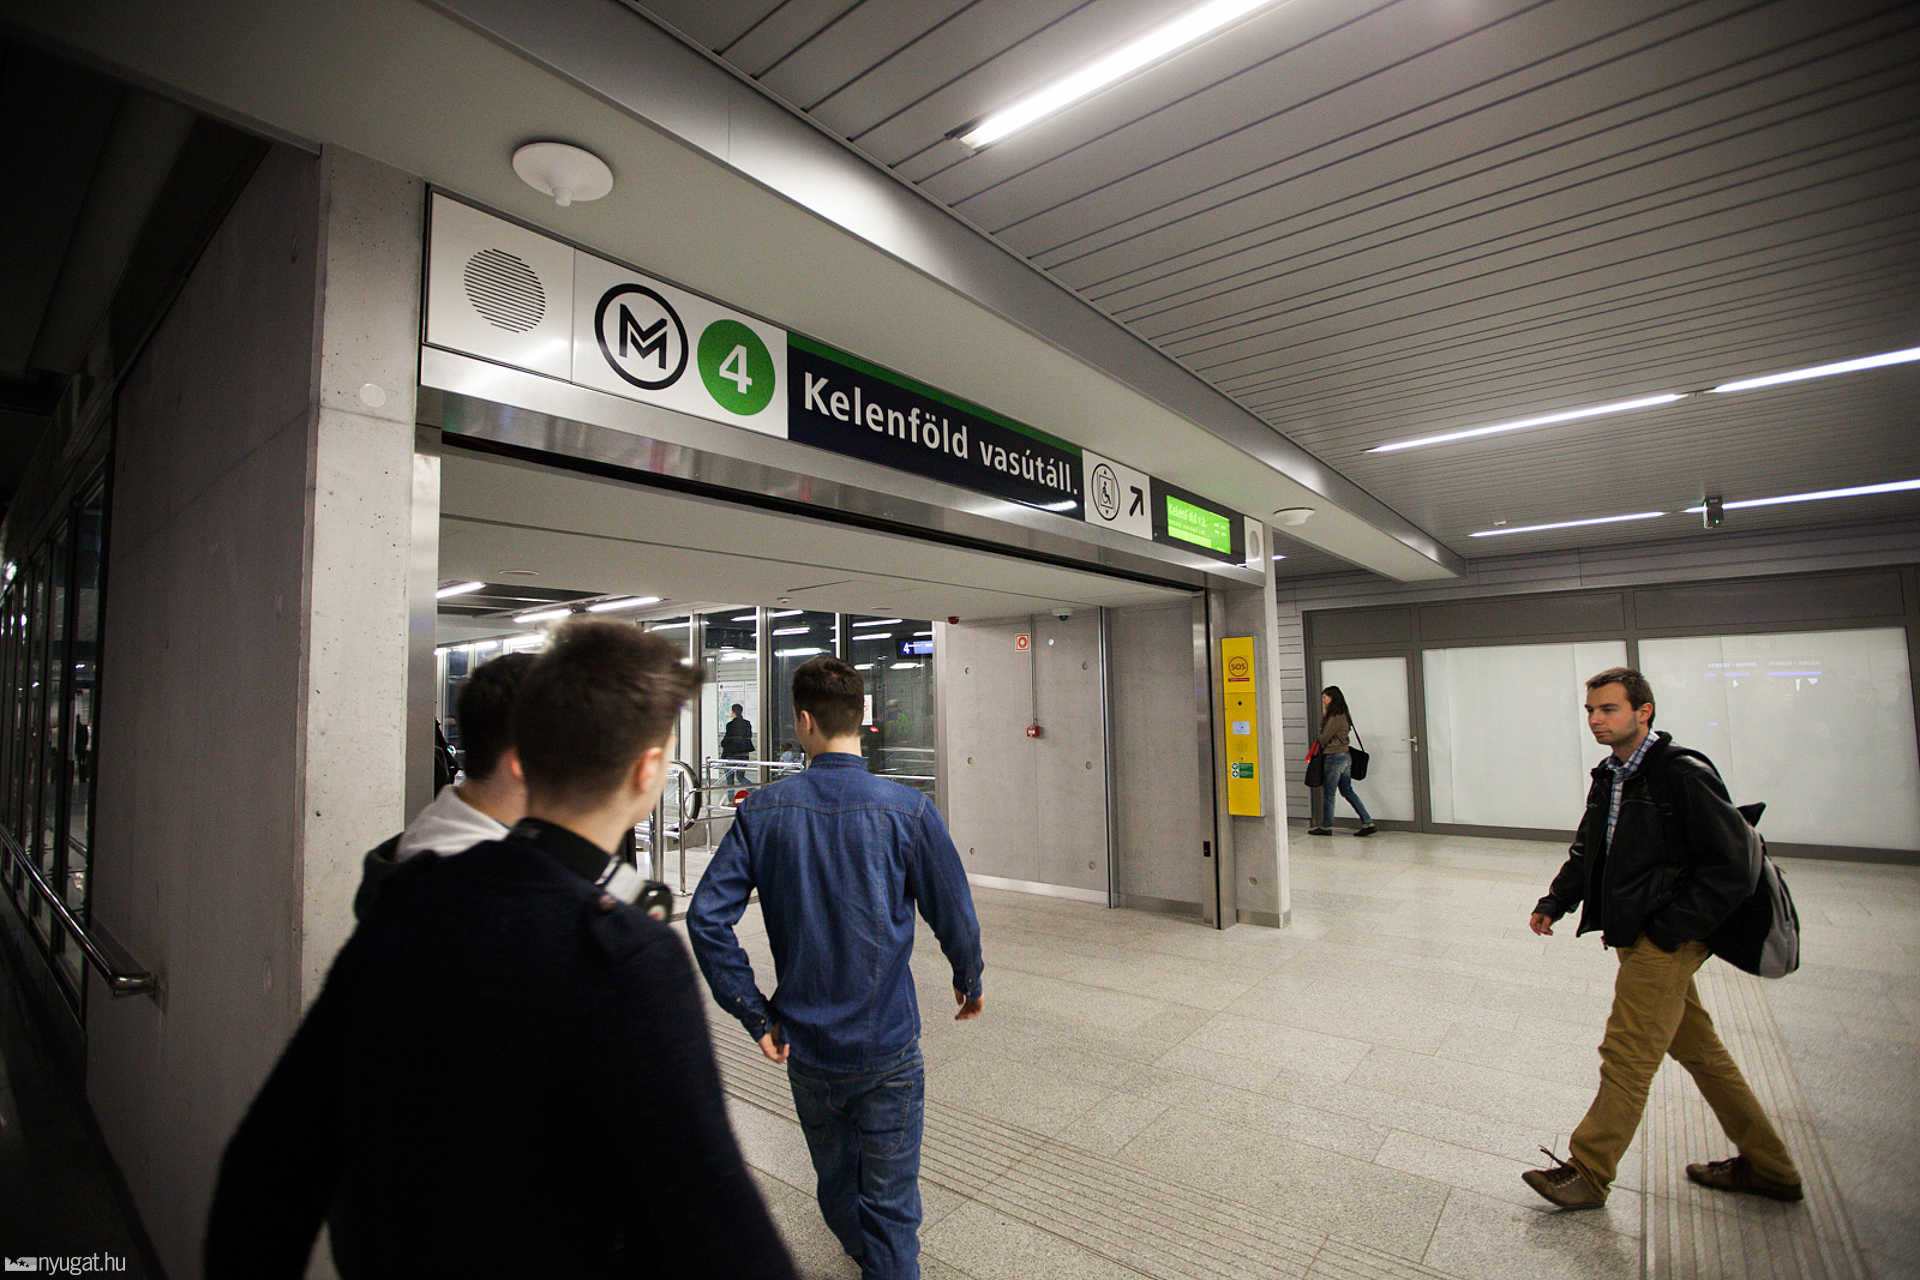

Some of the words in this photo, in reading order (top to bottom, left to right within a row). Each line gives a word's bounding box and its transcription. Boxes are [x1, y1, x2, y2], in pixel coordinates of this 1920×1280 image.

[719, 344, 753, 395] 4
[804, 371, 969, 460] Kelenföld
[979, 440, 1079, 495] vasútáll.
[903, 642, 910, 654] 4
[1230, 663, 1247, 671] SOS
